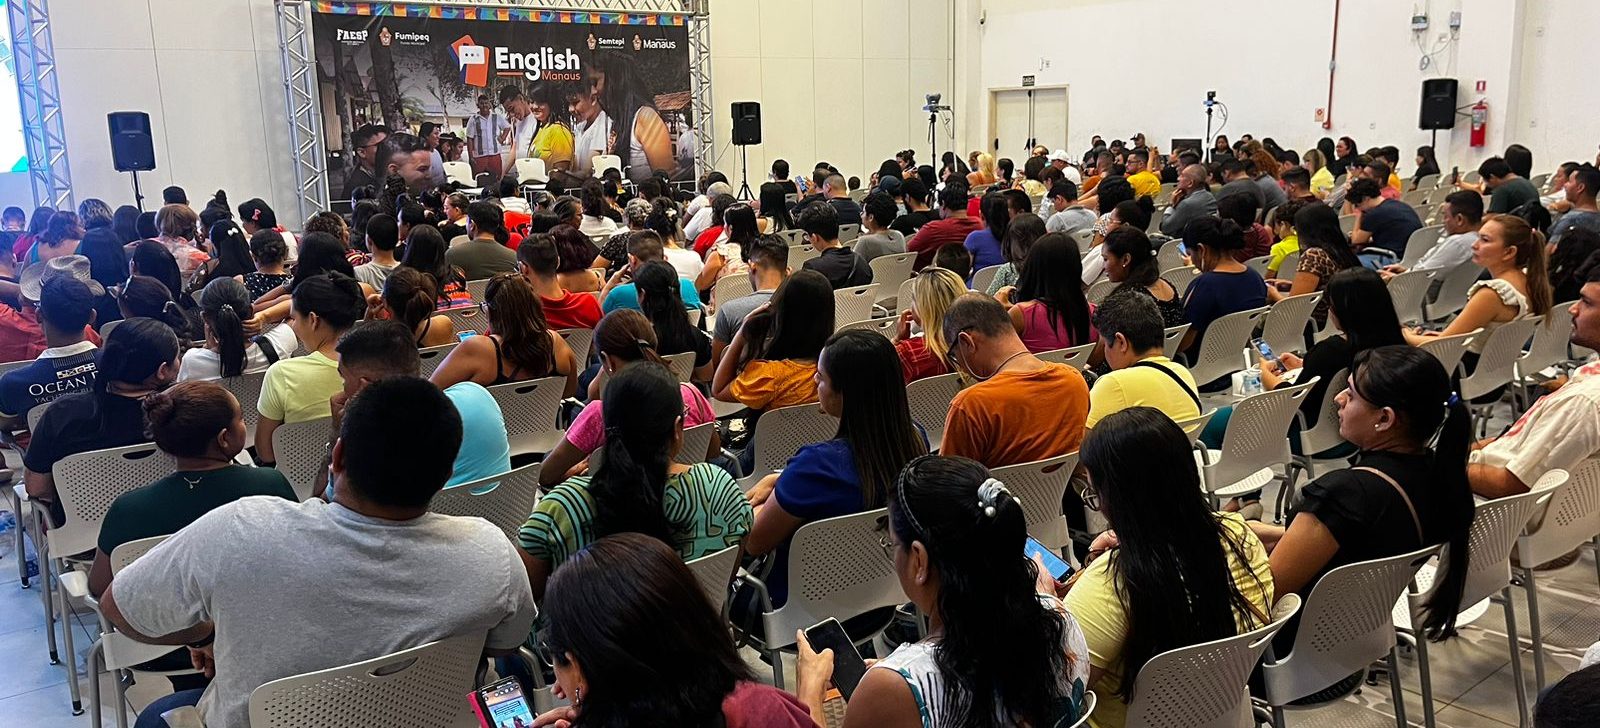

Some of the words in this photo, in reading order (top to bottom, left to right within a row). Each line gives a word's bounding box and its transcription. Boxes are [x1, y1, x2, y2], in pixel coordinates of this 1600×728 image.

[337, 28, 368, 41] FAESP
[395, 32, 430, 42] Fumipeq
[643, 39, 676, 49] Manaus
[495, 46, 580, 81] English
[542, 70, 581, 80] Manaus
[29, 375, 87, 396] OCEAN
